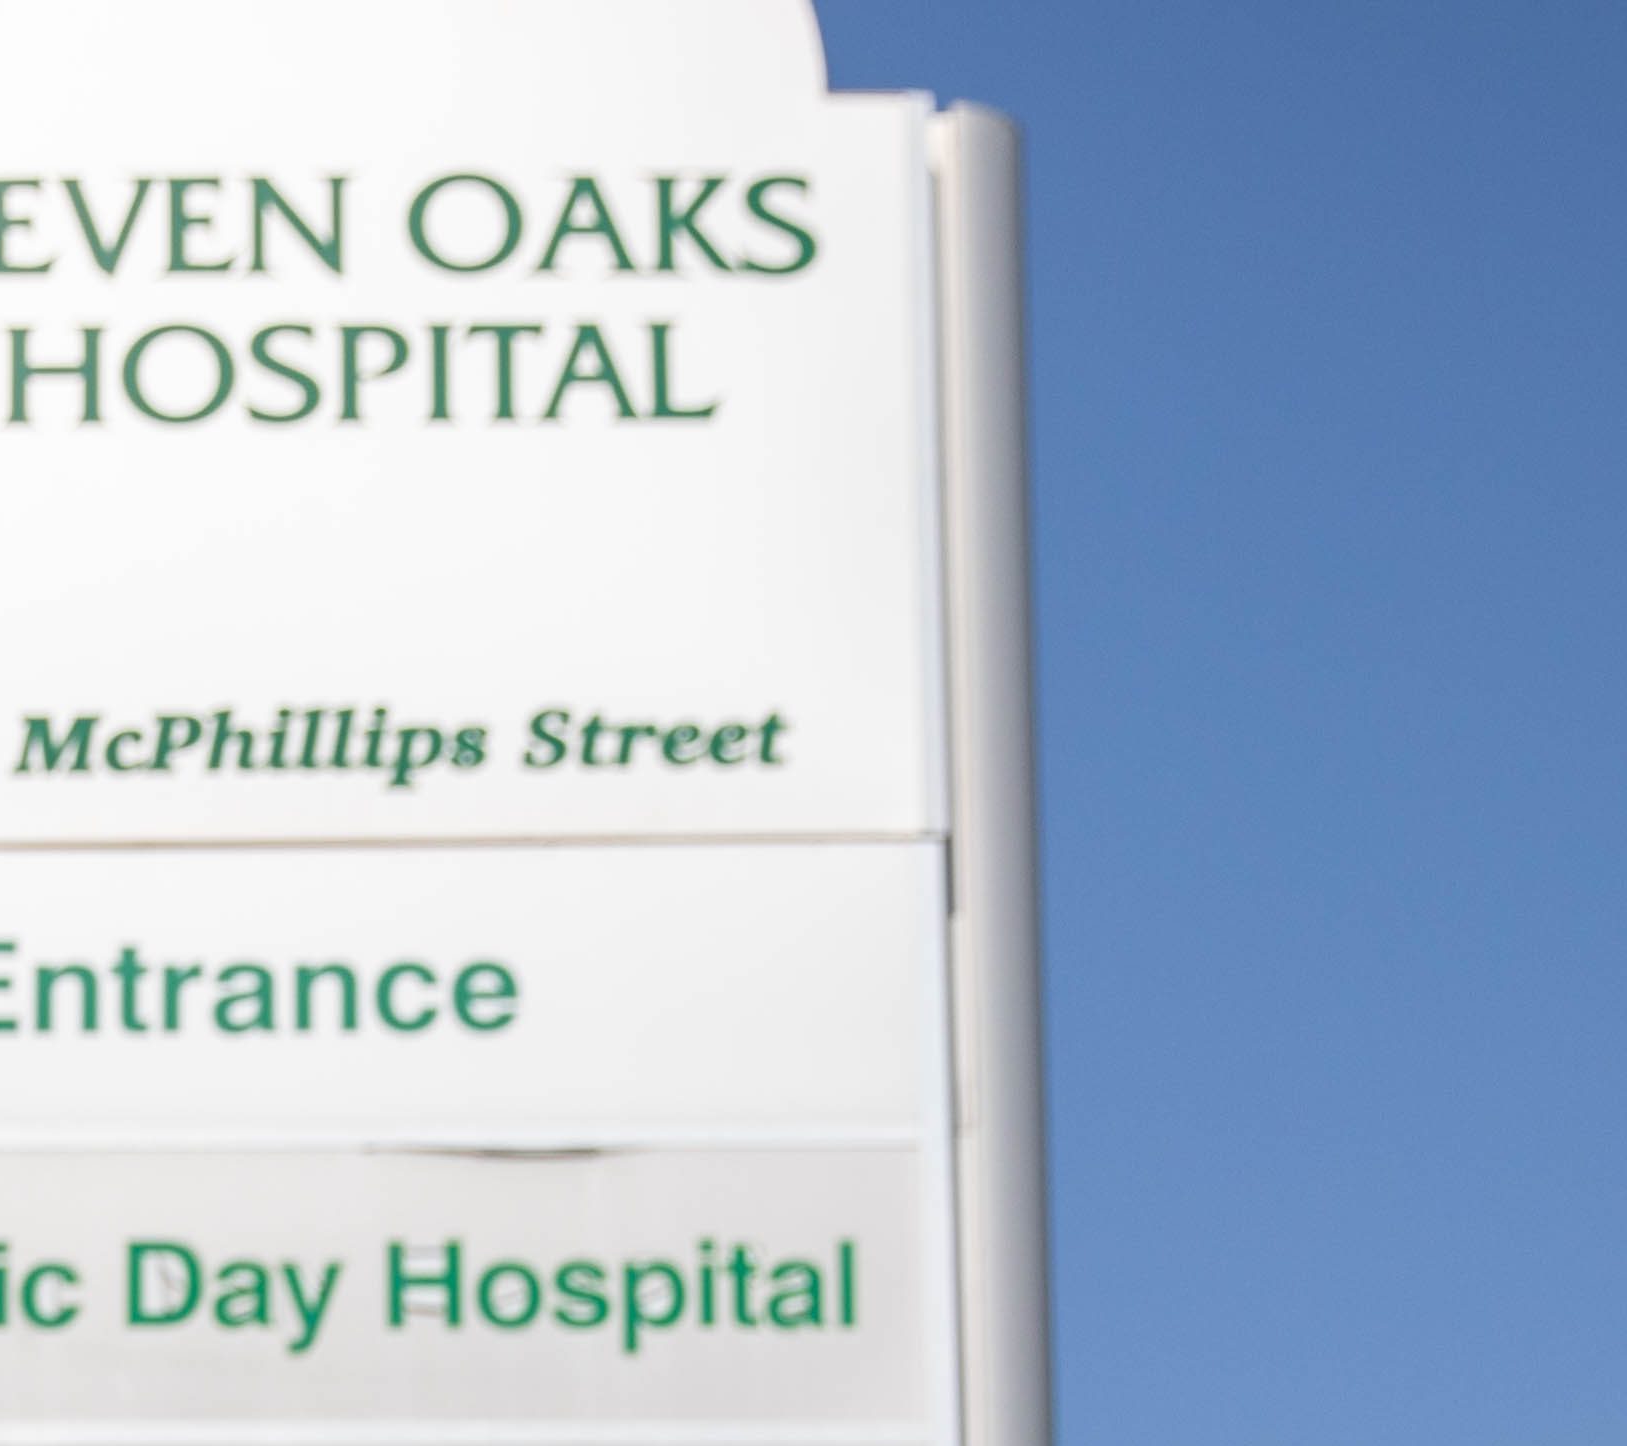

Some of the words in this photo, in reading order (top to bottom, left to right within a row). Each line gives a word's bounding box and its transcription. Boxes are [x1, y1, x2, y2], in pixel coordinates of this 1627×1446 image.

[407, 174, 821, 277] OAKS
[5, 322, 716, 424] HOSPITAL
[15, 706, 488, 789] McPhillips
[521, 709, 787, 770] Street
[123, 1238, 343, 1356] Day
[384, 1236, 859, 1355] Hospital
